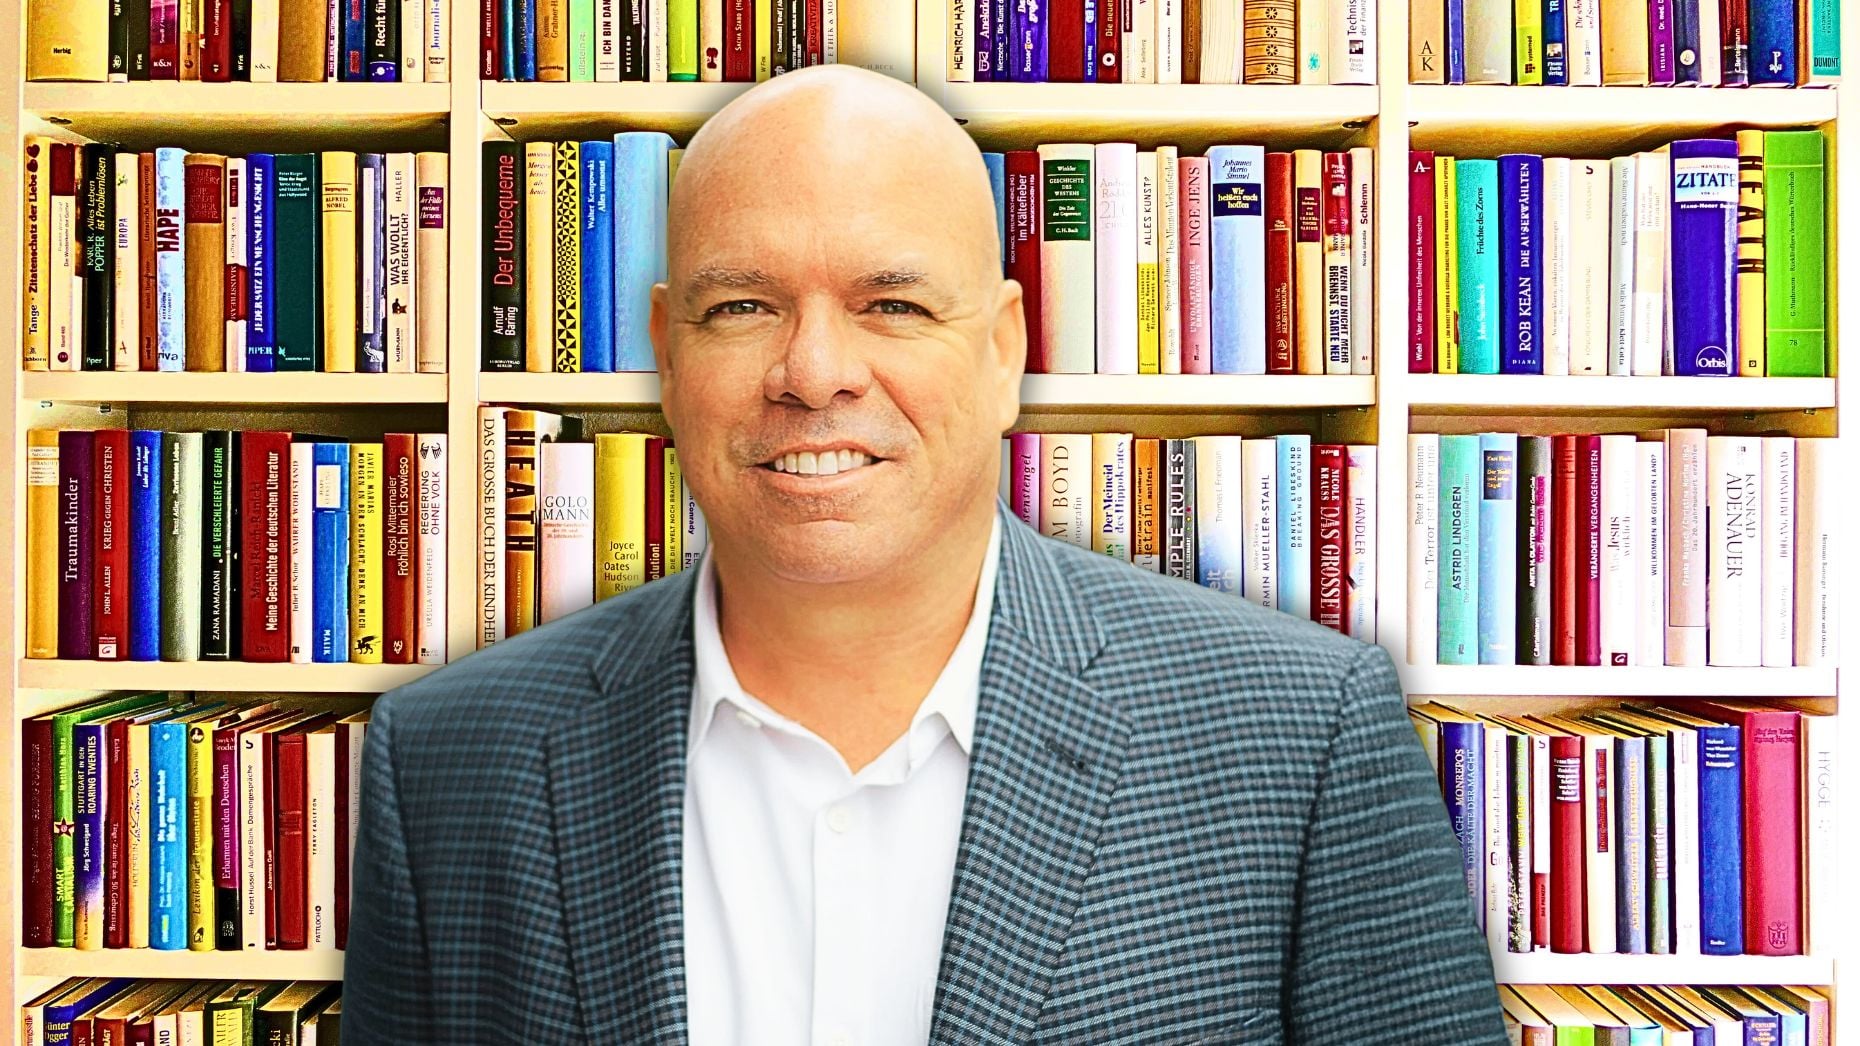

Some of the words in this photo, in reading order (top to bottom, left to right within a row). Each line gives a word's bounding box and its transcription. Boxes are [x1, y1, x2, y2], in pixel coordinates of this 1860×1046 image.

[375, 16, 385, 46] Recht
[603, 21, 612, 36] BIN
[603, 39, 612, 54] ICH
[954, 23, 964, 70] HEINRICH
[1421, 40, 1433, 54] A
[1422, 57, 1434, 71] K
[1814, 57, 1839, 68] DUMONT
[28, 175, 38, 202] Liebe
[87, 181, 95, 207] Leben
[95, 157, 106, 217] Problemlösen
[587, 160, 596, 203] Kempowski
[1143, 176, 1151, 213] KUNST?
[1188, 167, 1201, 204] JENS
[29, 204, 38, 222] der
[494, 155, 518, 251] Unbequeme
[1017, 175, 1028, 227] Kältefieber
[1360, 183, 1368, 224] Schlemm
[87, 208, 95, 230] Alles
[95, 218, 106, 230] ist
[157, 209, 180, 252] HAPE
[587, 205, 596, 229] Walter
[1143, 216, 1151, 246] ALLES
[1188, 209, 1201, 247] INGE
[1476, 212, 1485, 223] des
[119, 218, 128, 248] EUROPA
[390, 215, 400, 257] WOLLT
[401, 213, 409, 273] EIGENTLICH?
[1017, 230, 1028, 241] Im
[1476, 224, 1485, 255] Früchte
[29, 224, 38, 293] Zitatenschatz
[95, 236, 105, 271] POPPER
[390, 260, 400, 285] WAS
[401, 275, 409, 285] IHR
[494, 256, 514, 285] Der
[1340, 266, 1348, 290] WENN
[1340, 294, 1348, 305] DU
[1519, 277, 1531, 316] KEAN
[29, 305, 39, 335] Tange
[493, 306, 504, 335] Arnulf
[506, 306, 518, 335] Baring
[1340, 306, 1348, 334] NICHT
[1415, 323, 1423, 335] Von
[1340, 338, 1348, 363] MEHR
[1519, 322, 1531, 352] ROB
[1698, 357, 1726, 368] Orbis
[104, 446, 112, 493] CHRISTEN
[213, 448, 222, 478] GEFAHR
[266, 452, 279, 490] Literatur
[397, 457, 409, 499] sowieso
[1052, 446, 1069, 507] BOYD
[431, 471, 440, 499] VOLK
[1103, 464, 1113, 509] Meineid
[1321, 467, 1330, 501] KRAUSS
[1331, 469, 1340, 501] NICOLE
[1589, 450, 1599, 530] VERGANGENHEITEN
[213, 480, 222, 542] VERSCHLEIERTE
[266, 492, 279, 537] deutschen
[388, 476, 397, 533] Mittermaier
[397, 502, 409, 516] ich
[421, 470, 429, 535] REGIERUNG
[543, 509, 590, 520] MANN
[545, 496, 587, 507] GOLO
[1452, 486, 1462, 545] LINDGREN
[1745, 473, 1756, 538] KONRAD
[65, 477, 78, 582] Traumakinder
[397, 520, 409, 535] bin
[431, 502, 440, 535] OHNE
[1103, 512, 1113, 533] Der
[1262, 474, 1270, 571] MUELLER-STAHL
[1320, 506, 1340, 539] DAS
[1607, 516, 1620, 550] Jesus
[1726, 472, 1743, 579] ADENAUER
[104, 521, 112, 549] KRIEG
[266, 539, 279, 553] der
[388, 536, 397, 557] Rosi
[609, 541, 635, 551] Joyce
[213, 545, 222, 557] DIE
[397, 539, 409, 576] Fröhlich
[614, 551, 638, 560] Carol
[1589, 532, 1599, 579] VERÄNDERTE
[266, 555, 279, 602] Geschichte
[604, 562, 630, 571] Oates
[1320, 545, 1340, 608] GROSSE
[1452, 549, 1462, 590] ASTRID
[1262, 576, 1270, 606] RMIN
[266, 604, 279, 631] Meine
[87, 736, 97, 775] TWENTIES
[221, 764, 231, 805] Deutschen
[1455, 749, 1464, 805] MONREPOS
[87, 777, 97, 814] ROARING
[221, 807, 231, 823] den
[83, 823, 91, 857] Schweigard
[221, 826, 231, 838] mit
[83, 858, 91, 871] Jörg
[221, 840, 231, 879] Erbarmen
[56, 868, 65, 902] SMART
